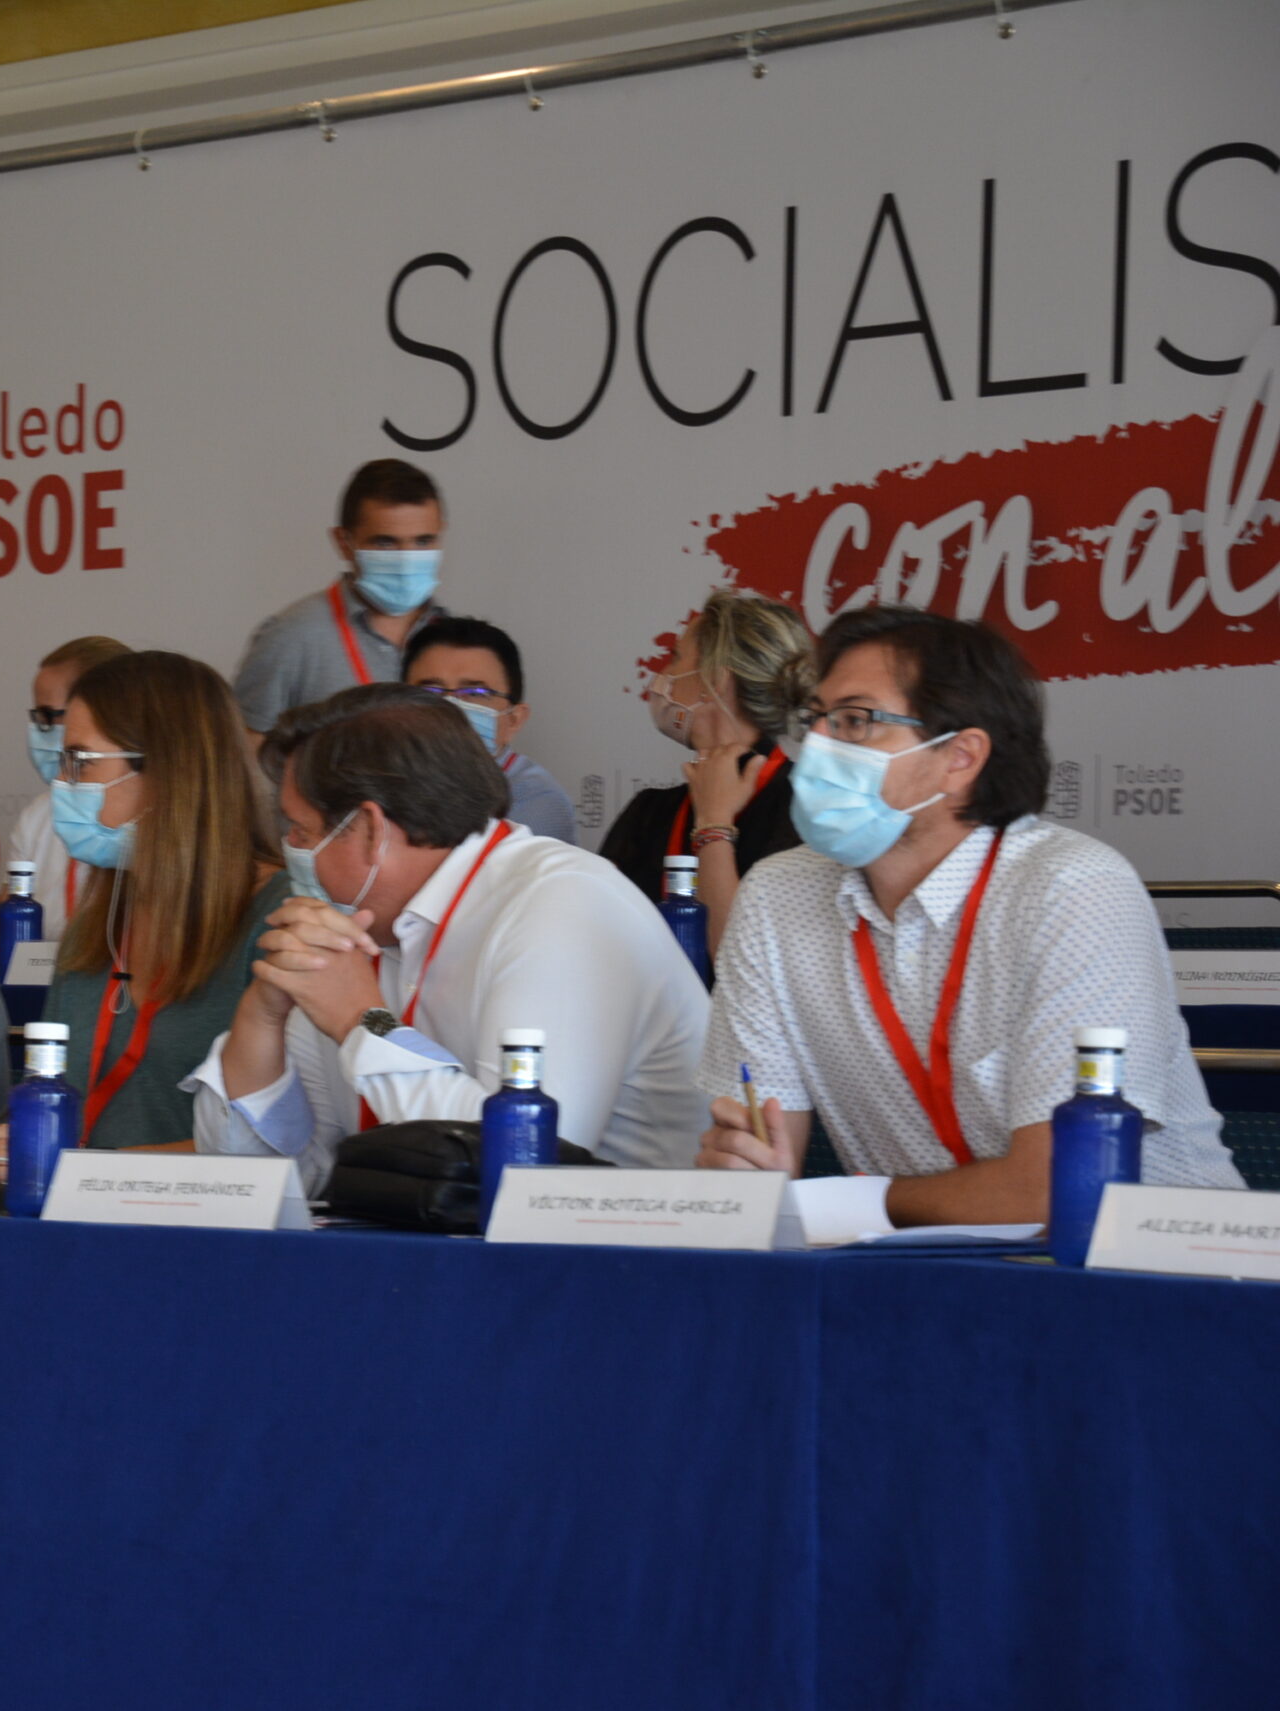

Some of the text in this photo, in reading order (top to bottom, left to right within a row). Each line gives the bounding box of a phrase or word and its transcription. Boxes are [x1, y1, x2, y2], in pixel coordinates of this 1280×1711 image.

[380, 141, 1280, 453] SOCIALIS
[802, 494, 1060, 636] con
[1112, 763, 1185, 785] Toledo
[1111, 786, 1185, 817] PSOE
[76, 1176, 256, 1198] FÉLIX ORTEGA FERNÁNDEZ
[527, 1193, 743, 1215] VÍCTOR BOTICA GARCÍA
[1135, 1217, 1215, 1236] ALICIA
